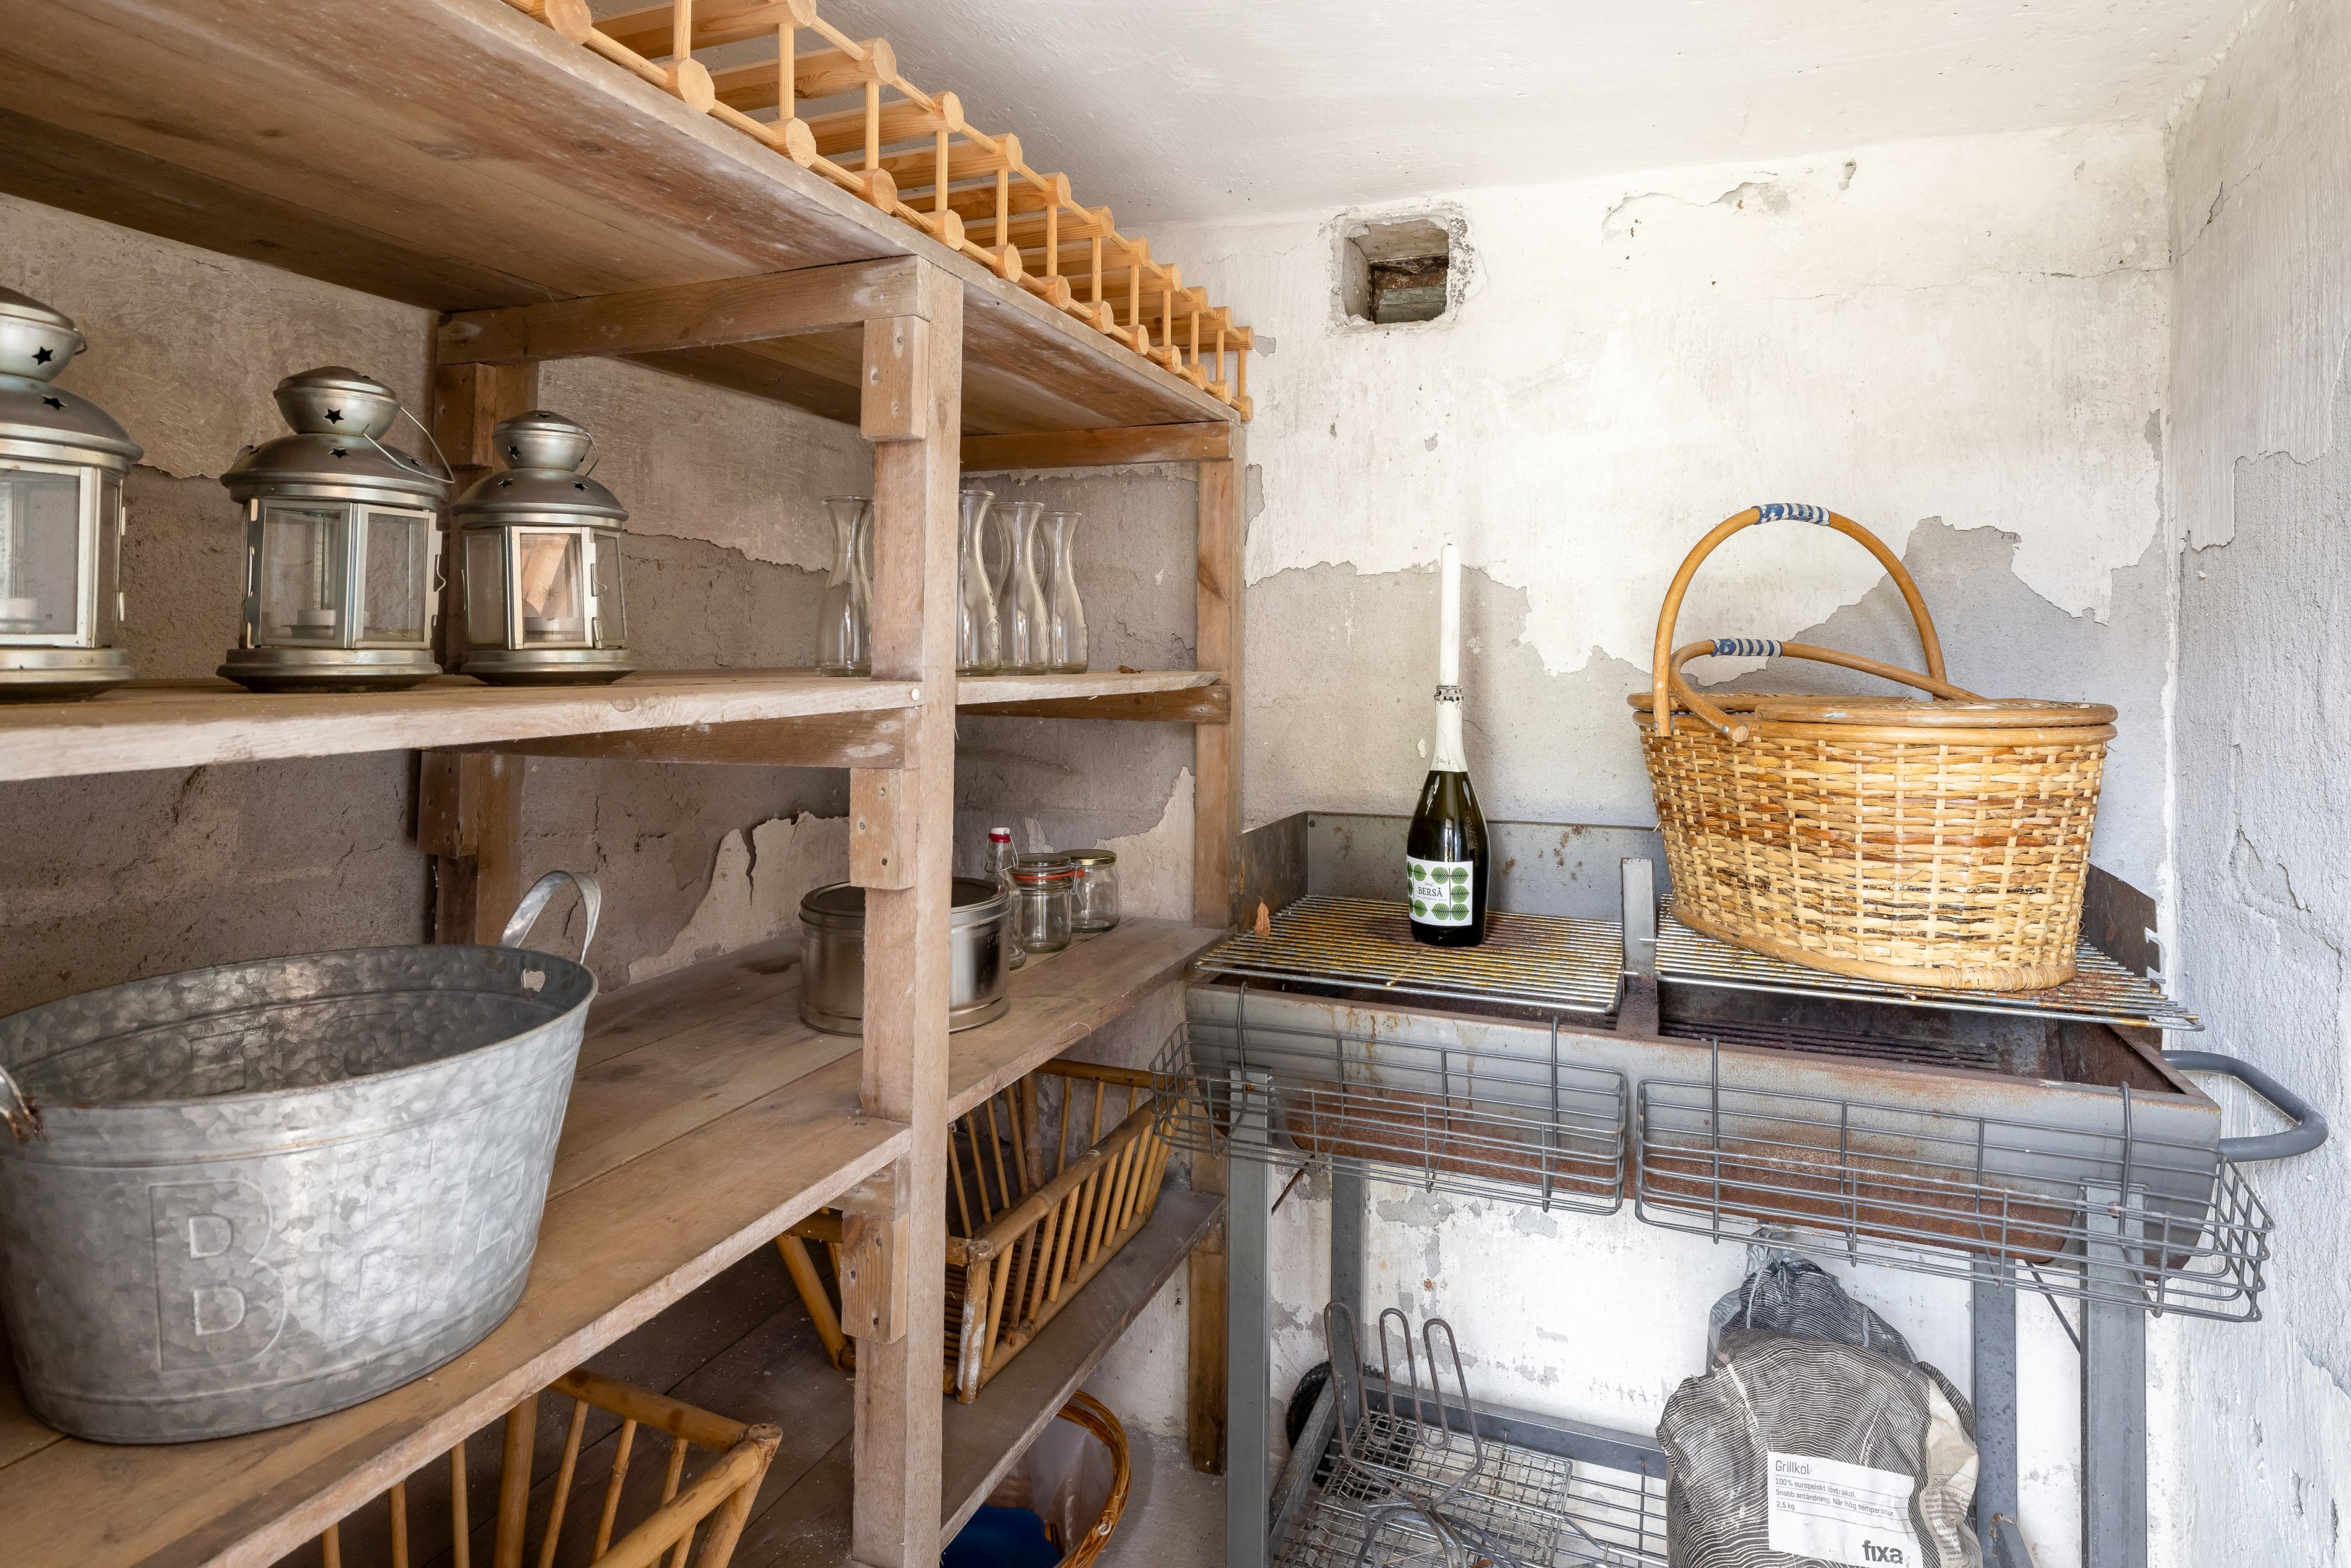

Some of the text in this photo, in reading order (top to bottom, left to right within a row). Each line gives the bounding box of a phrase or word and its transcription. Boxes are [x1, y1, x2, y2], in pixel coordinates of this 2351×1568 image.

[1418, 886, 1443, 897] BERSÅ
[1775, 1460, 1809, 1475] Grillkol
[1794, 1482, 1826, 1492] europeiskt
[1828, 1485, 1857, 1498] lövträkol.
[1775, 1488, 1896, 1517] Snabb antändning. När hög temperatur.
[1776, 1500, 1786, 1509] 2,5
[1862, 1540, 1903, 1564] fixa
